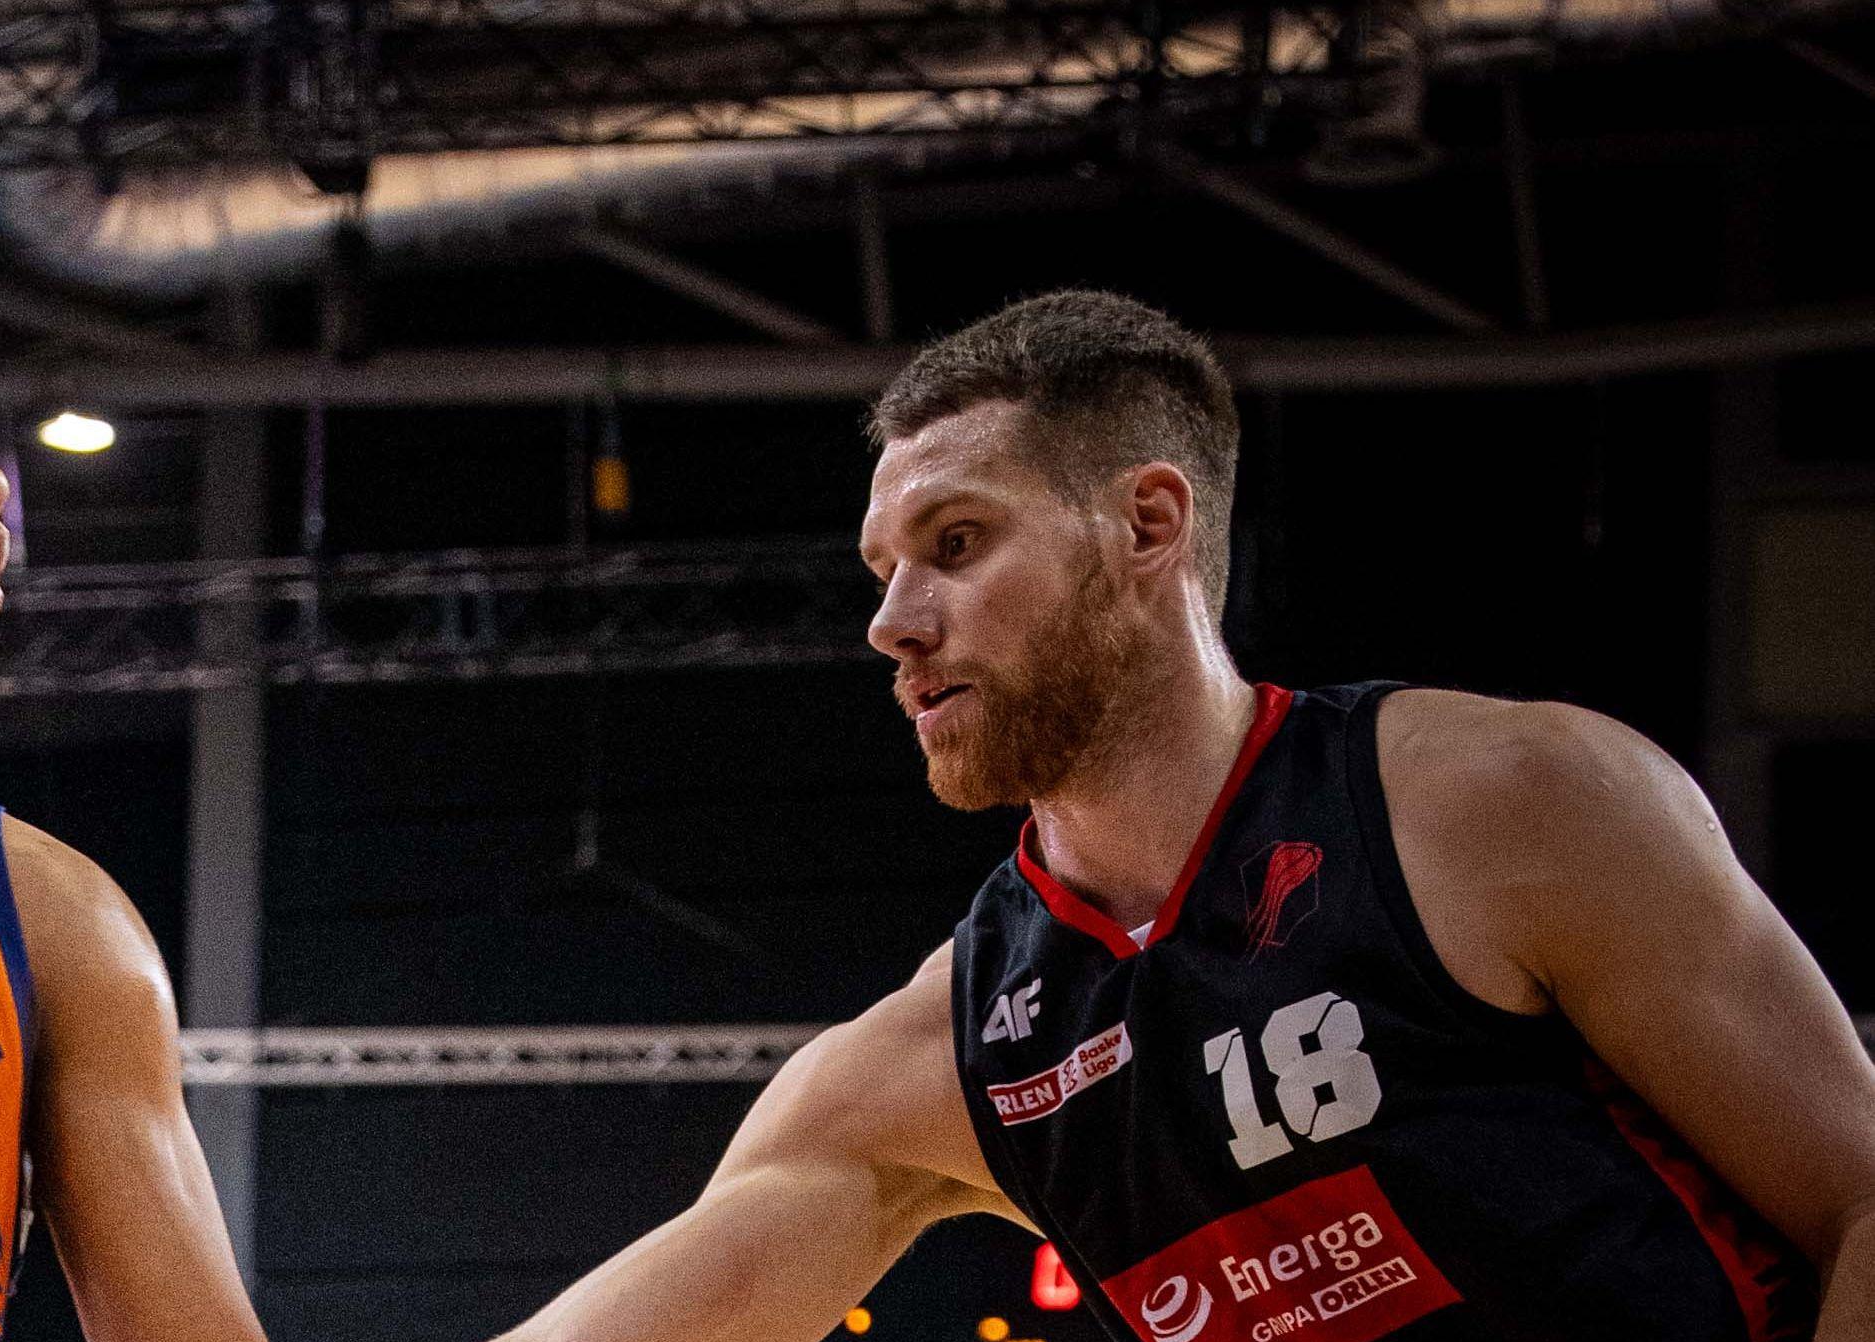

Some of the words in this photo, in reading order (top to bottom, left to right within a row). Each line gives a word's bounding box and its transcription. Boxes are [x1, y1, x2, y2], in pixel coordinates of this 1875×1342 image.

[981, 978, 1042, 1044] 4F
[1083, 1054, 1118, 1078] Liga
[1204, 990, 1382, 1170] 18
[1219, 1211, 1384, 1303] Energa
[1319, 1260, 1410, 1313] ORLEN
